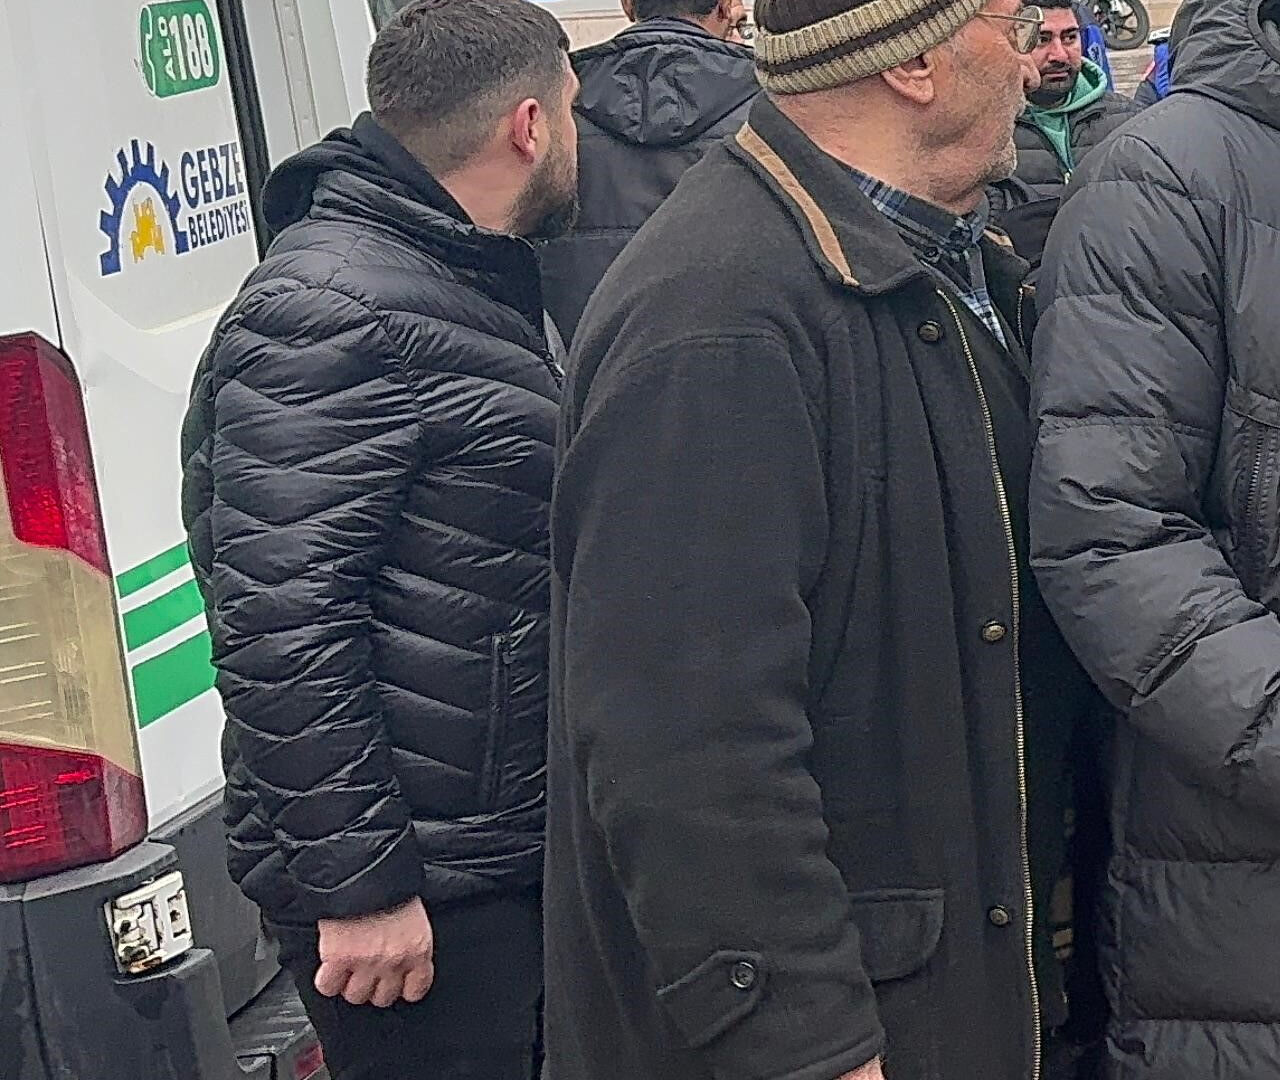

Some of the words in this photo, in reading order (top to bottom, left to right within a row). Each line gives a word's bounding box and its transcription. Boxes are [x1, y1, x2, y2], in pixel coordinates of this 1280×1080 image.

[158, 16, 177, 81] ALO
[168, 13, 214, 80] 188
[181, 141, 245, 210] GEBZE
